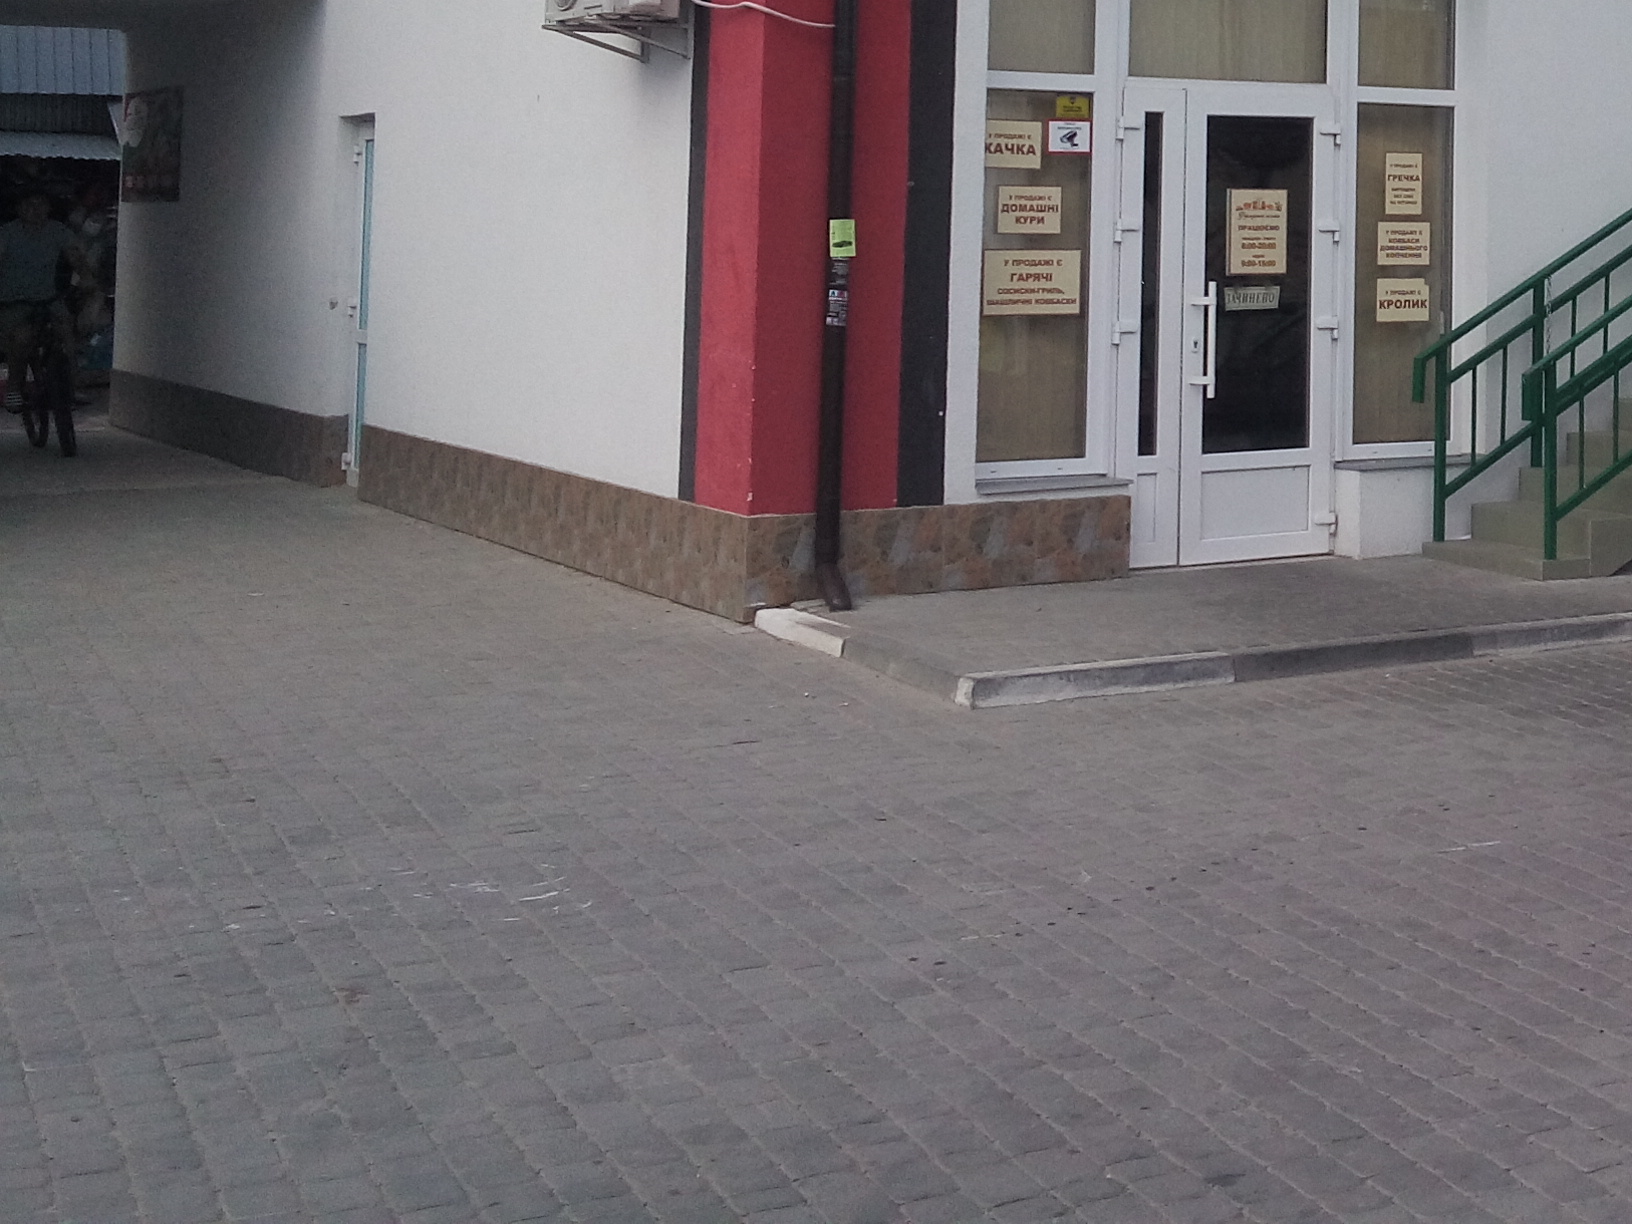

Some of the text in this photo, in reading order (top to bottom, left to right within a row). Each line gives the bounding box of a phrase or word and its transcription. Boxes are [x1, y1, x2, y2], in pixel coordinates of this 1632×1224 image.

[985, 142, 1037, 156] КАЧКА
[1000, 203, 1059, 214] ДОМАШНІ
[1015, 216, 1045, 225] КУРИ
[1010, 272, 1053, 283] ГАРЯЧІ
[1378, 299, 1428, 310] КРОЛИК
